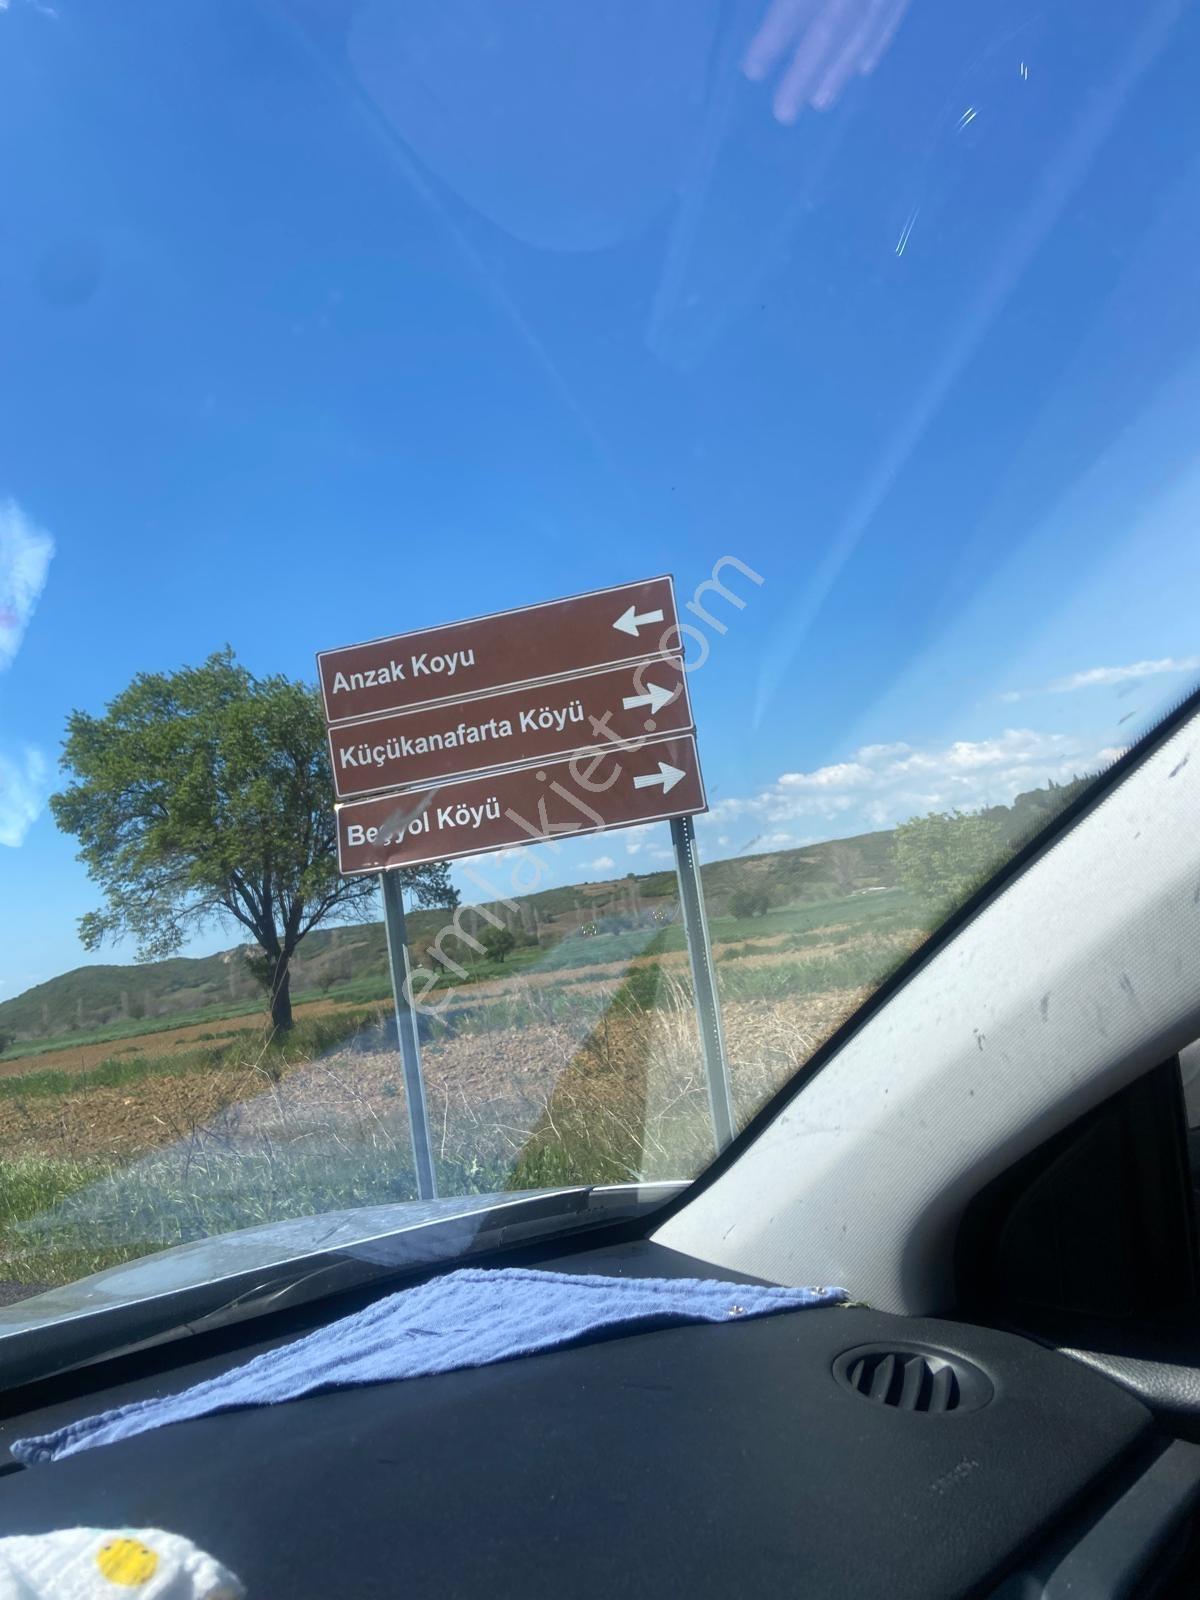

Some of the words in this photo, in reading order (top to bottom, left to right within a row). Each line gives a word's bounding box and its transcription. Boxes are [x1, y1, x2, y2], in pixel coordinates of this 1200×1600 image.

[331, 665, 406, 694] Anzak
[411, 648, 476, 678] Koyu
[339, 718, 513, 768] Küçükanafarta
[518, 699, 585, 733] Köyü
[436, 796, 501, 830] Köyü
